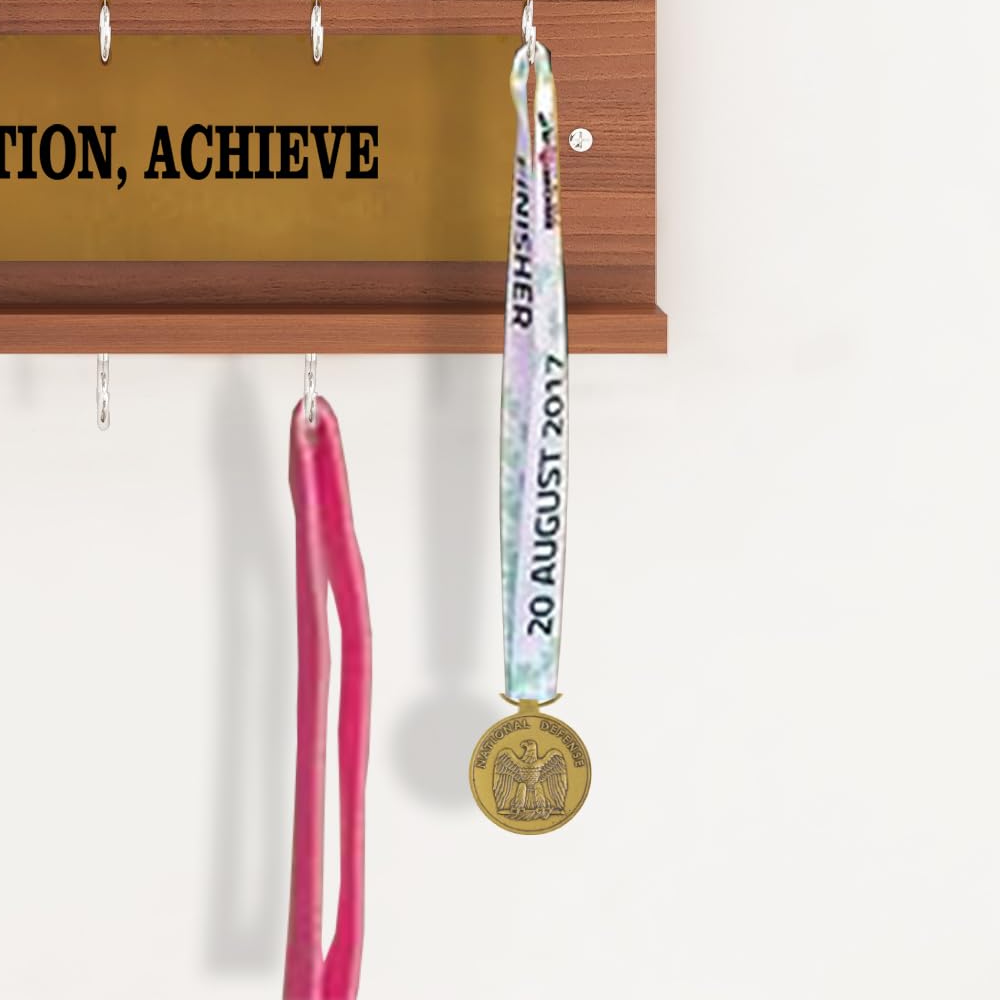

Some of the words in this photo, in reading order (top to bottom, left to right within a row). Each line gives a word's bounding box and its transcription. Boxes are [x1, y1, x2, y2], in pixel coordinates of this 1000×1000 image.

[143, 123, 378, 180] ACHIEVE
[541, 354, 564, 438] 2017
[530, 448, 562, 586] AUGUST
[526, 595, 556, 636] 20
[474, 718, 532, 770] NATIONAL
[539, 719, 585, 769] DEFENSE
